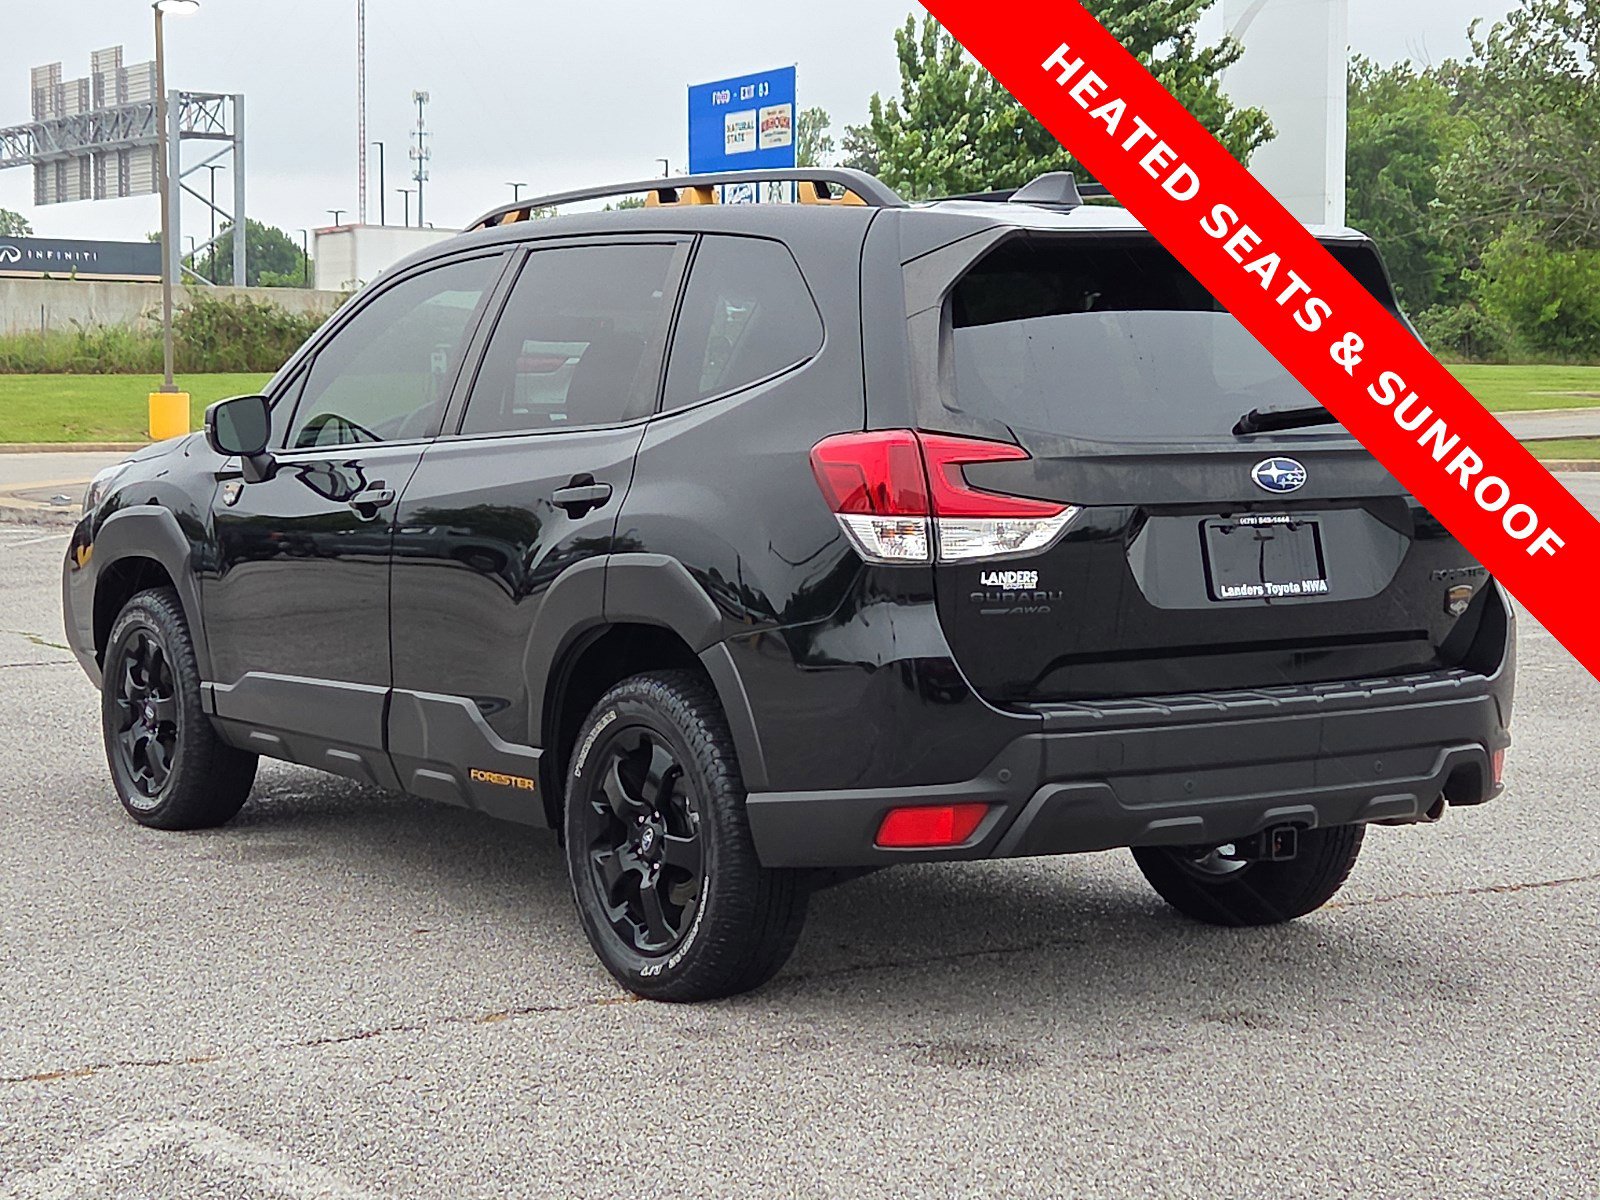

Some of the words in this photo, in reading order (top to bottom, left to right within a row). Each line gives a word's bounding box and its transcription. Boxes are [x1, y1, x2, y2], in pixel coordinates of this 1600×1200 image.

[740, 84, 755, 101] EXIT
[27, 249, 98, 262] INFINITI
[980, 570, 1039, 585] LANDERS
[1221, 584, 1263, 597] Landers
[1265, 582, 1300, 596] Toyota
[1301, 579, 1328, 592] NWA
[970, 590, 1063, 602] SUBARU
[1009, 605, 1052, 614] AWD
[470, 768, 535, 791] FORESTER
